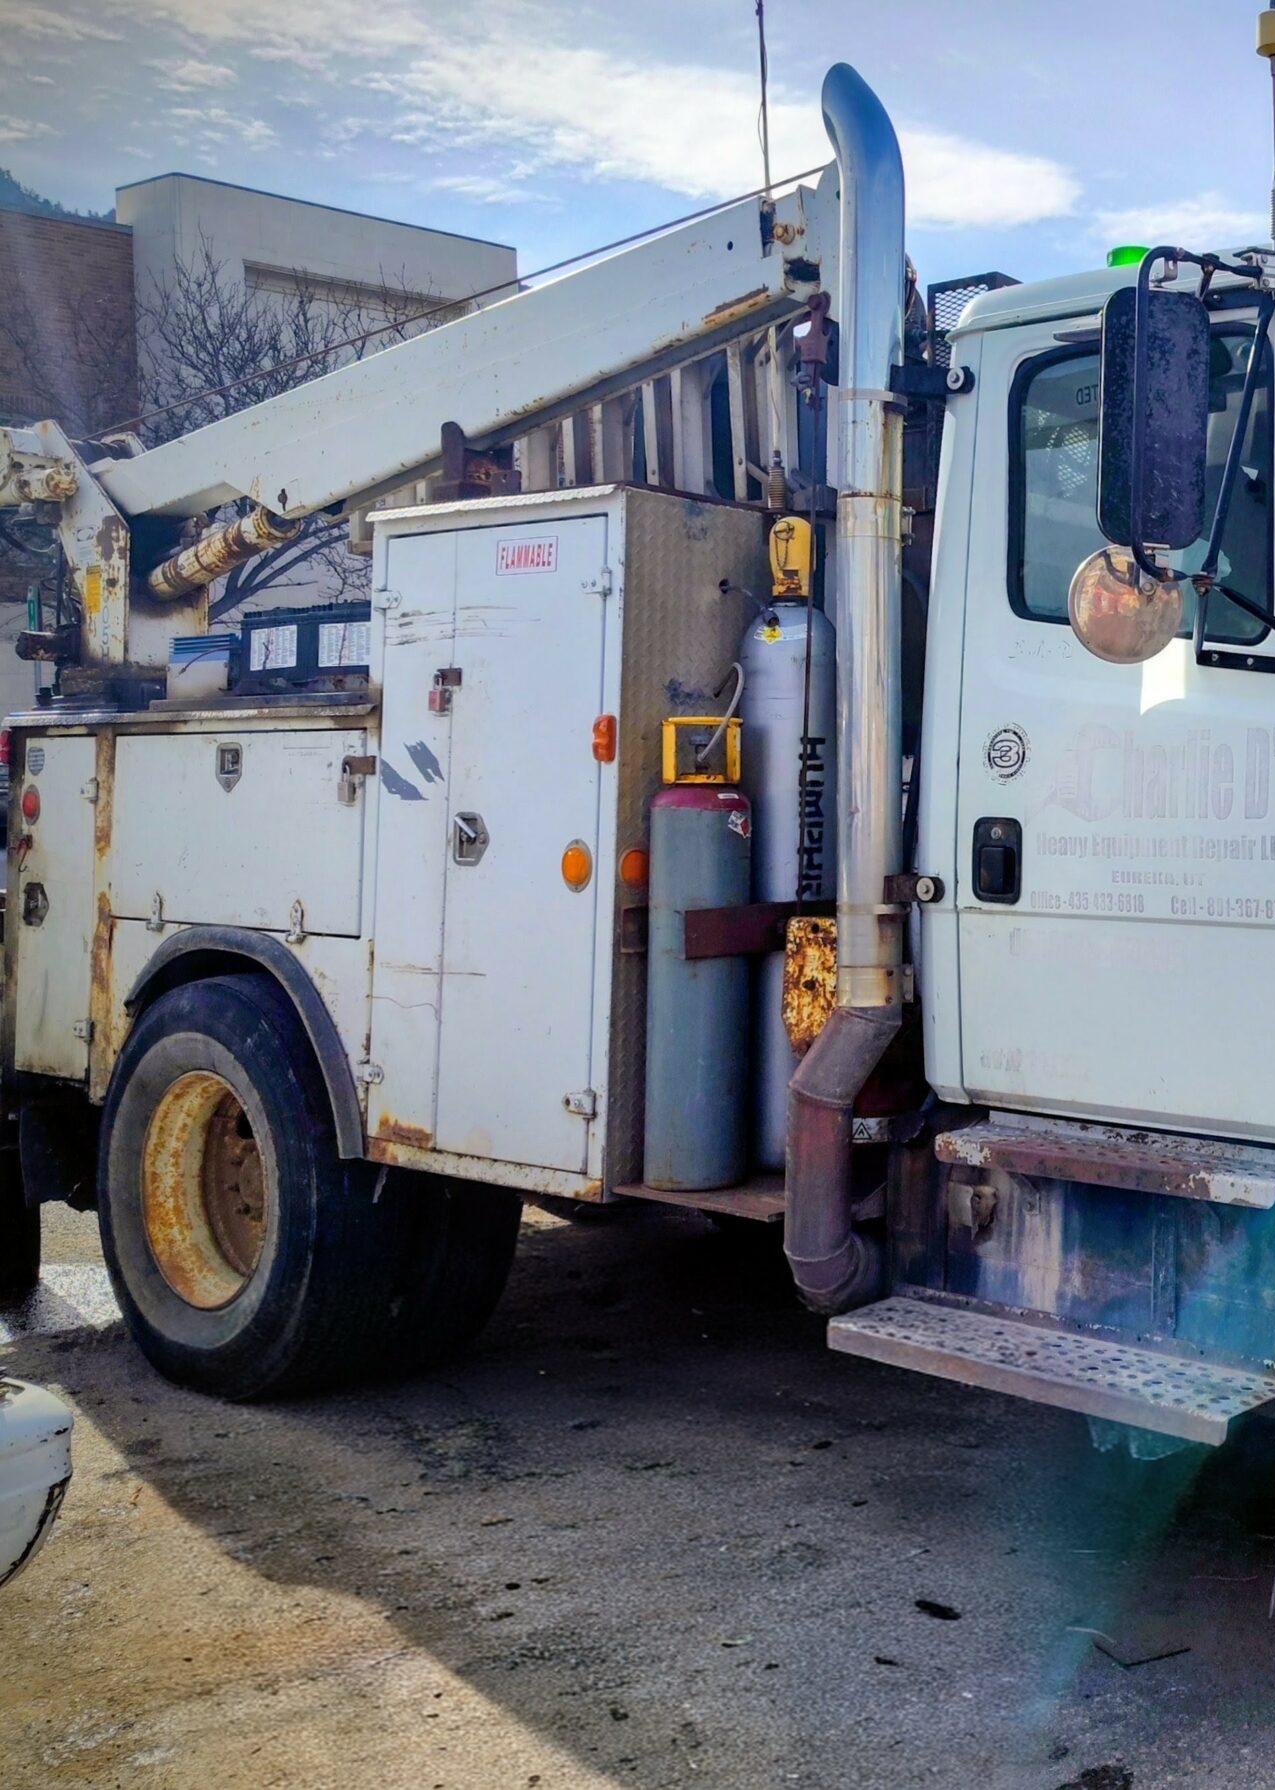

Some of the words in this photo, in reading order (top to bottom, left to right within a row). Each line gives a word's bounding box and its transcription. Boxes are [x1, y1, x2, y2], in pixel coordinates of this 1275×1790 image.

[500, 543, 554, 570] FLAMMABLE
[1070, 723, 1234, 820] Charlie
[1036, 832, 1088, 858] Heavy
[1091, 833, 1188, 860] Equipment
[1192, 834, 1257, 862] Repair
